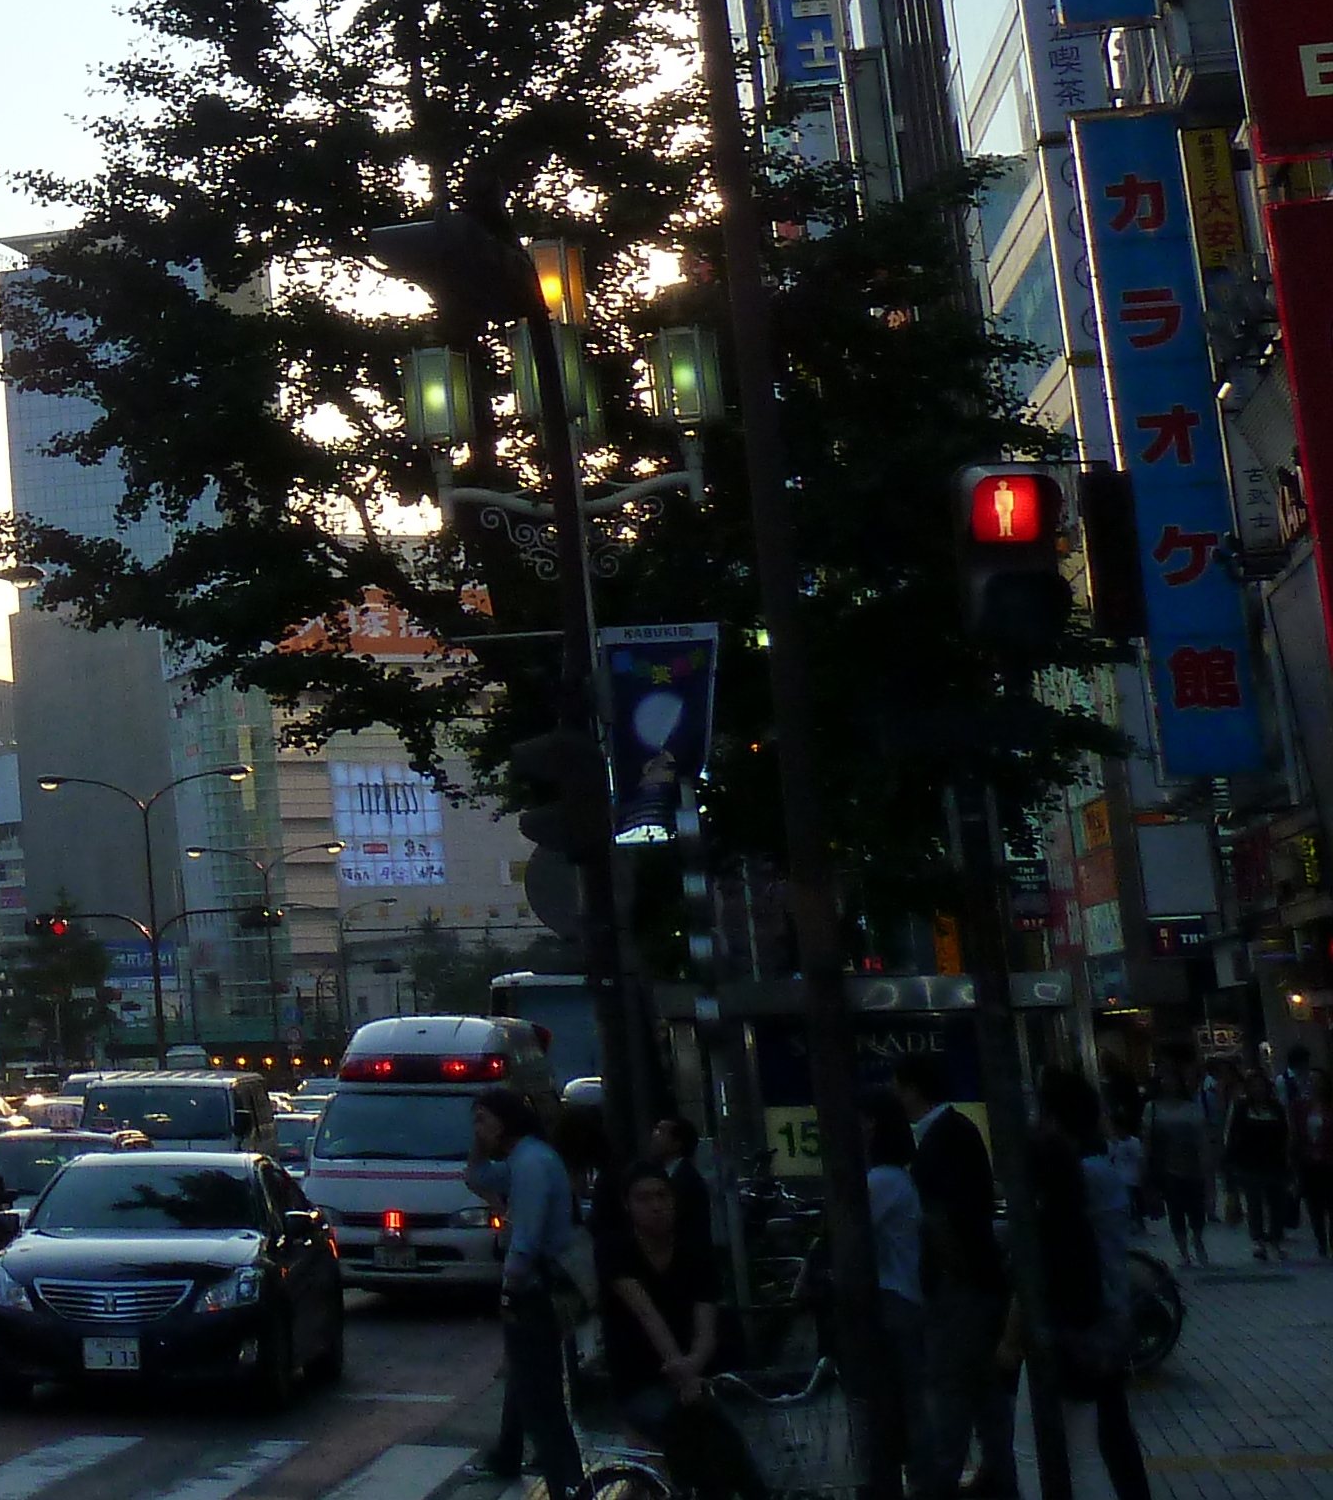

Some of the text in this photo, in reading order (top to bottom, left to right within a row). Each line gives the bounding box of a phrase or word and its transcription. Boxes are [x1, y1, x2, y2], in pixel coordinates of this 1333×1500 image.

[1106, 172, 1243, 711] カラオケ館
[357, 782, 419, 816] TIPESS
